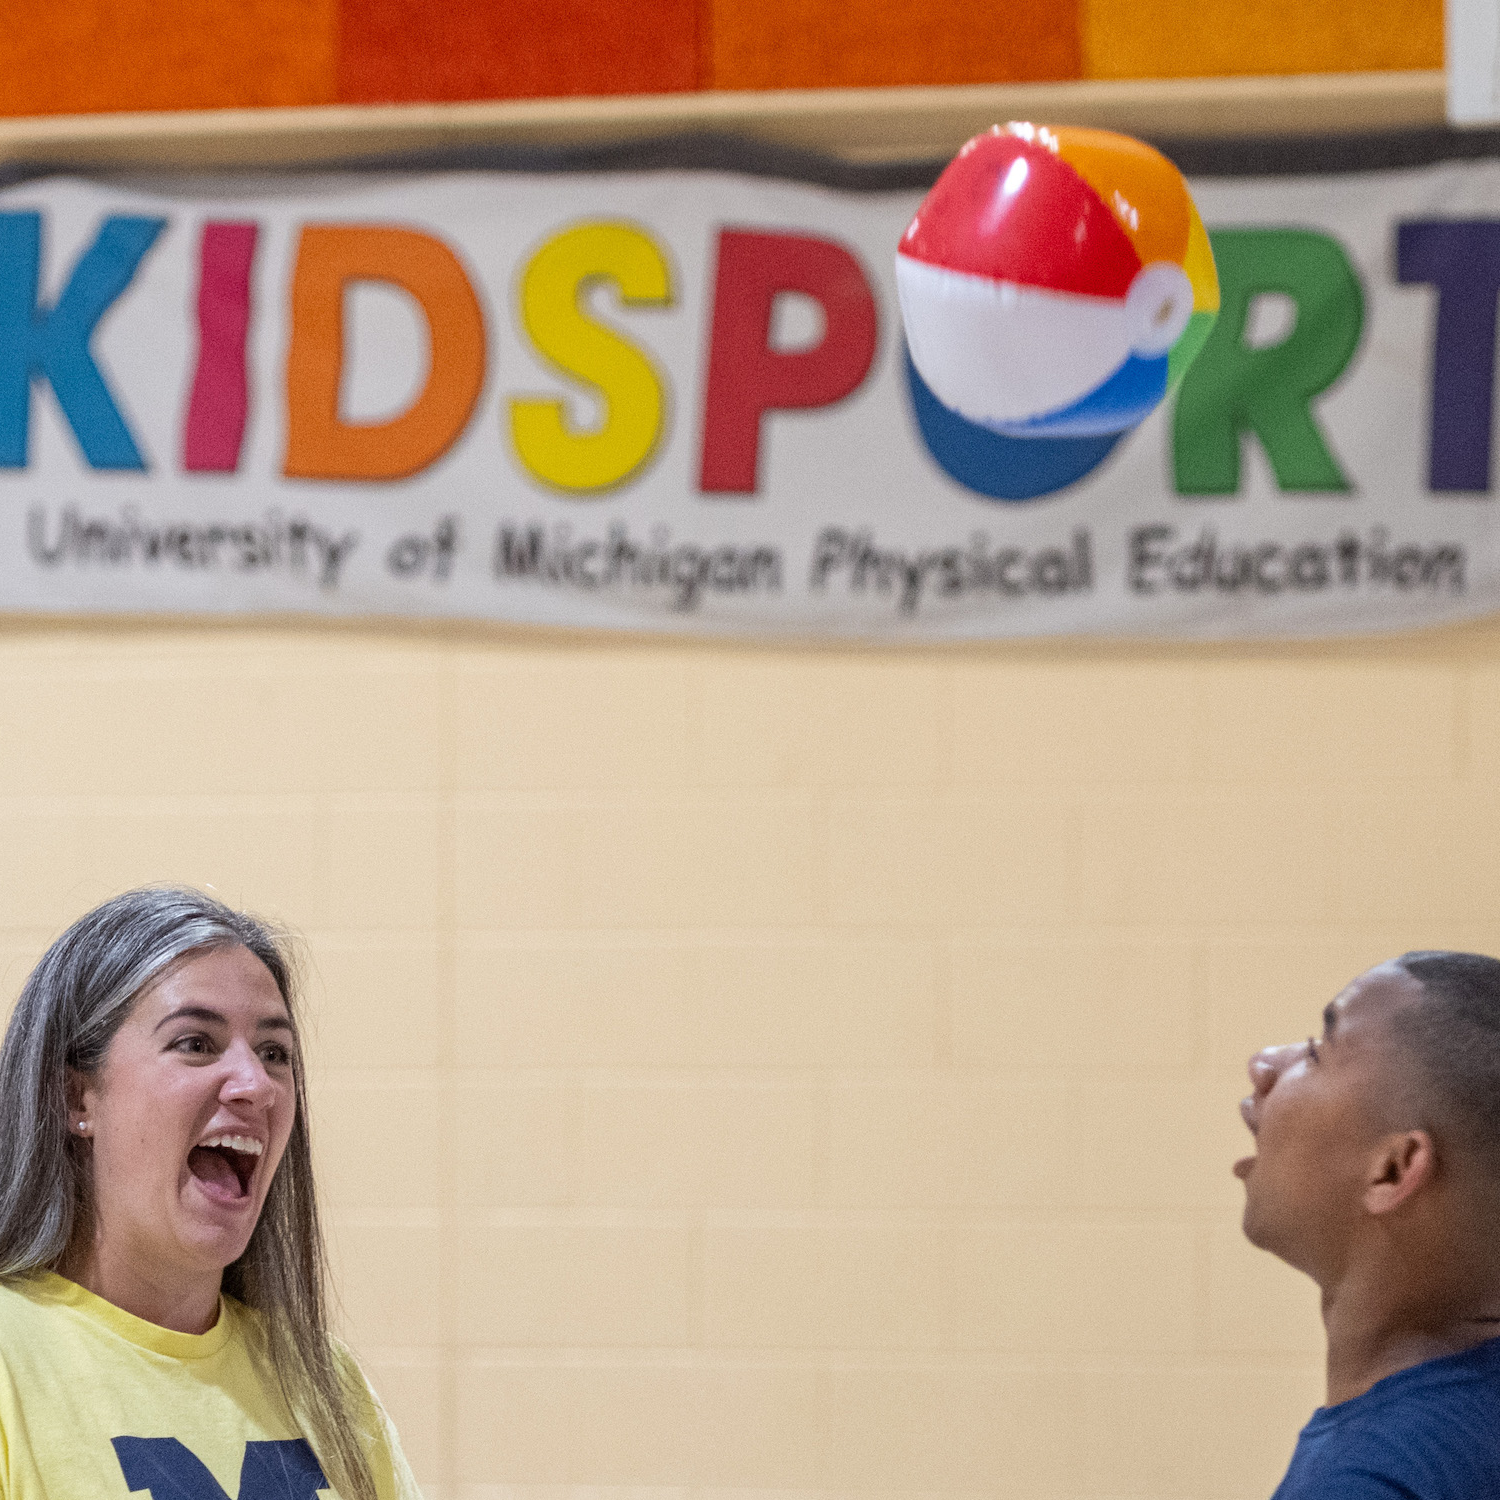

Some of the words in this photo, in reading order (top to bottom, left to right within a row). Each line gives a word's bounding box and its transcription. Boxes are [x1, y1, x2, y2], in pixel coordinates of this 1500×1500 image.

[27, 504, 356, 586] University
[387, 522, 462, 579] of
[494, 520, 783, 613] Michigan
[810, 526, 1095, 614] Physical
[1125, 522, 1467, 597] Education
